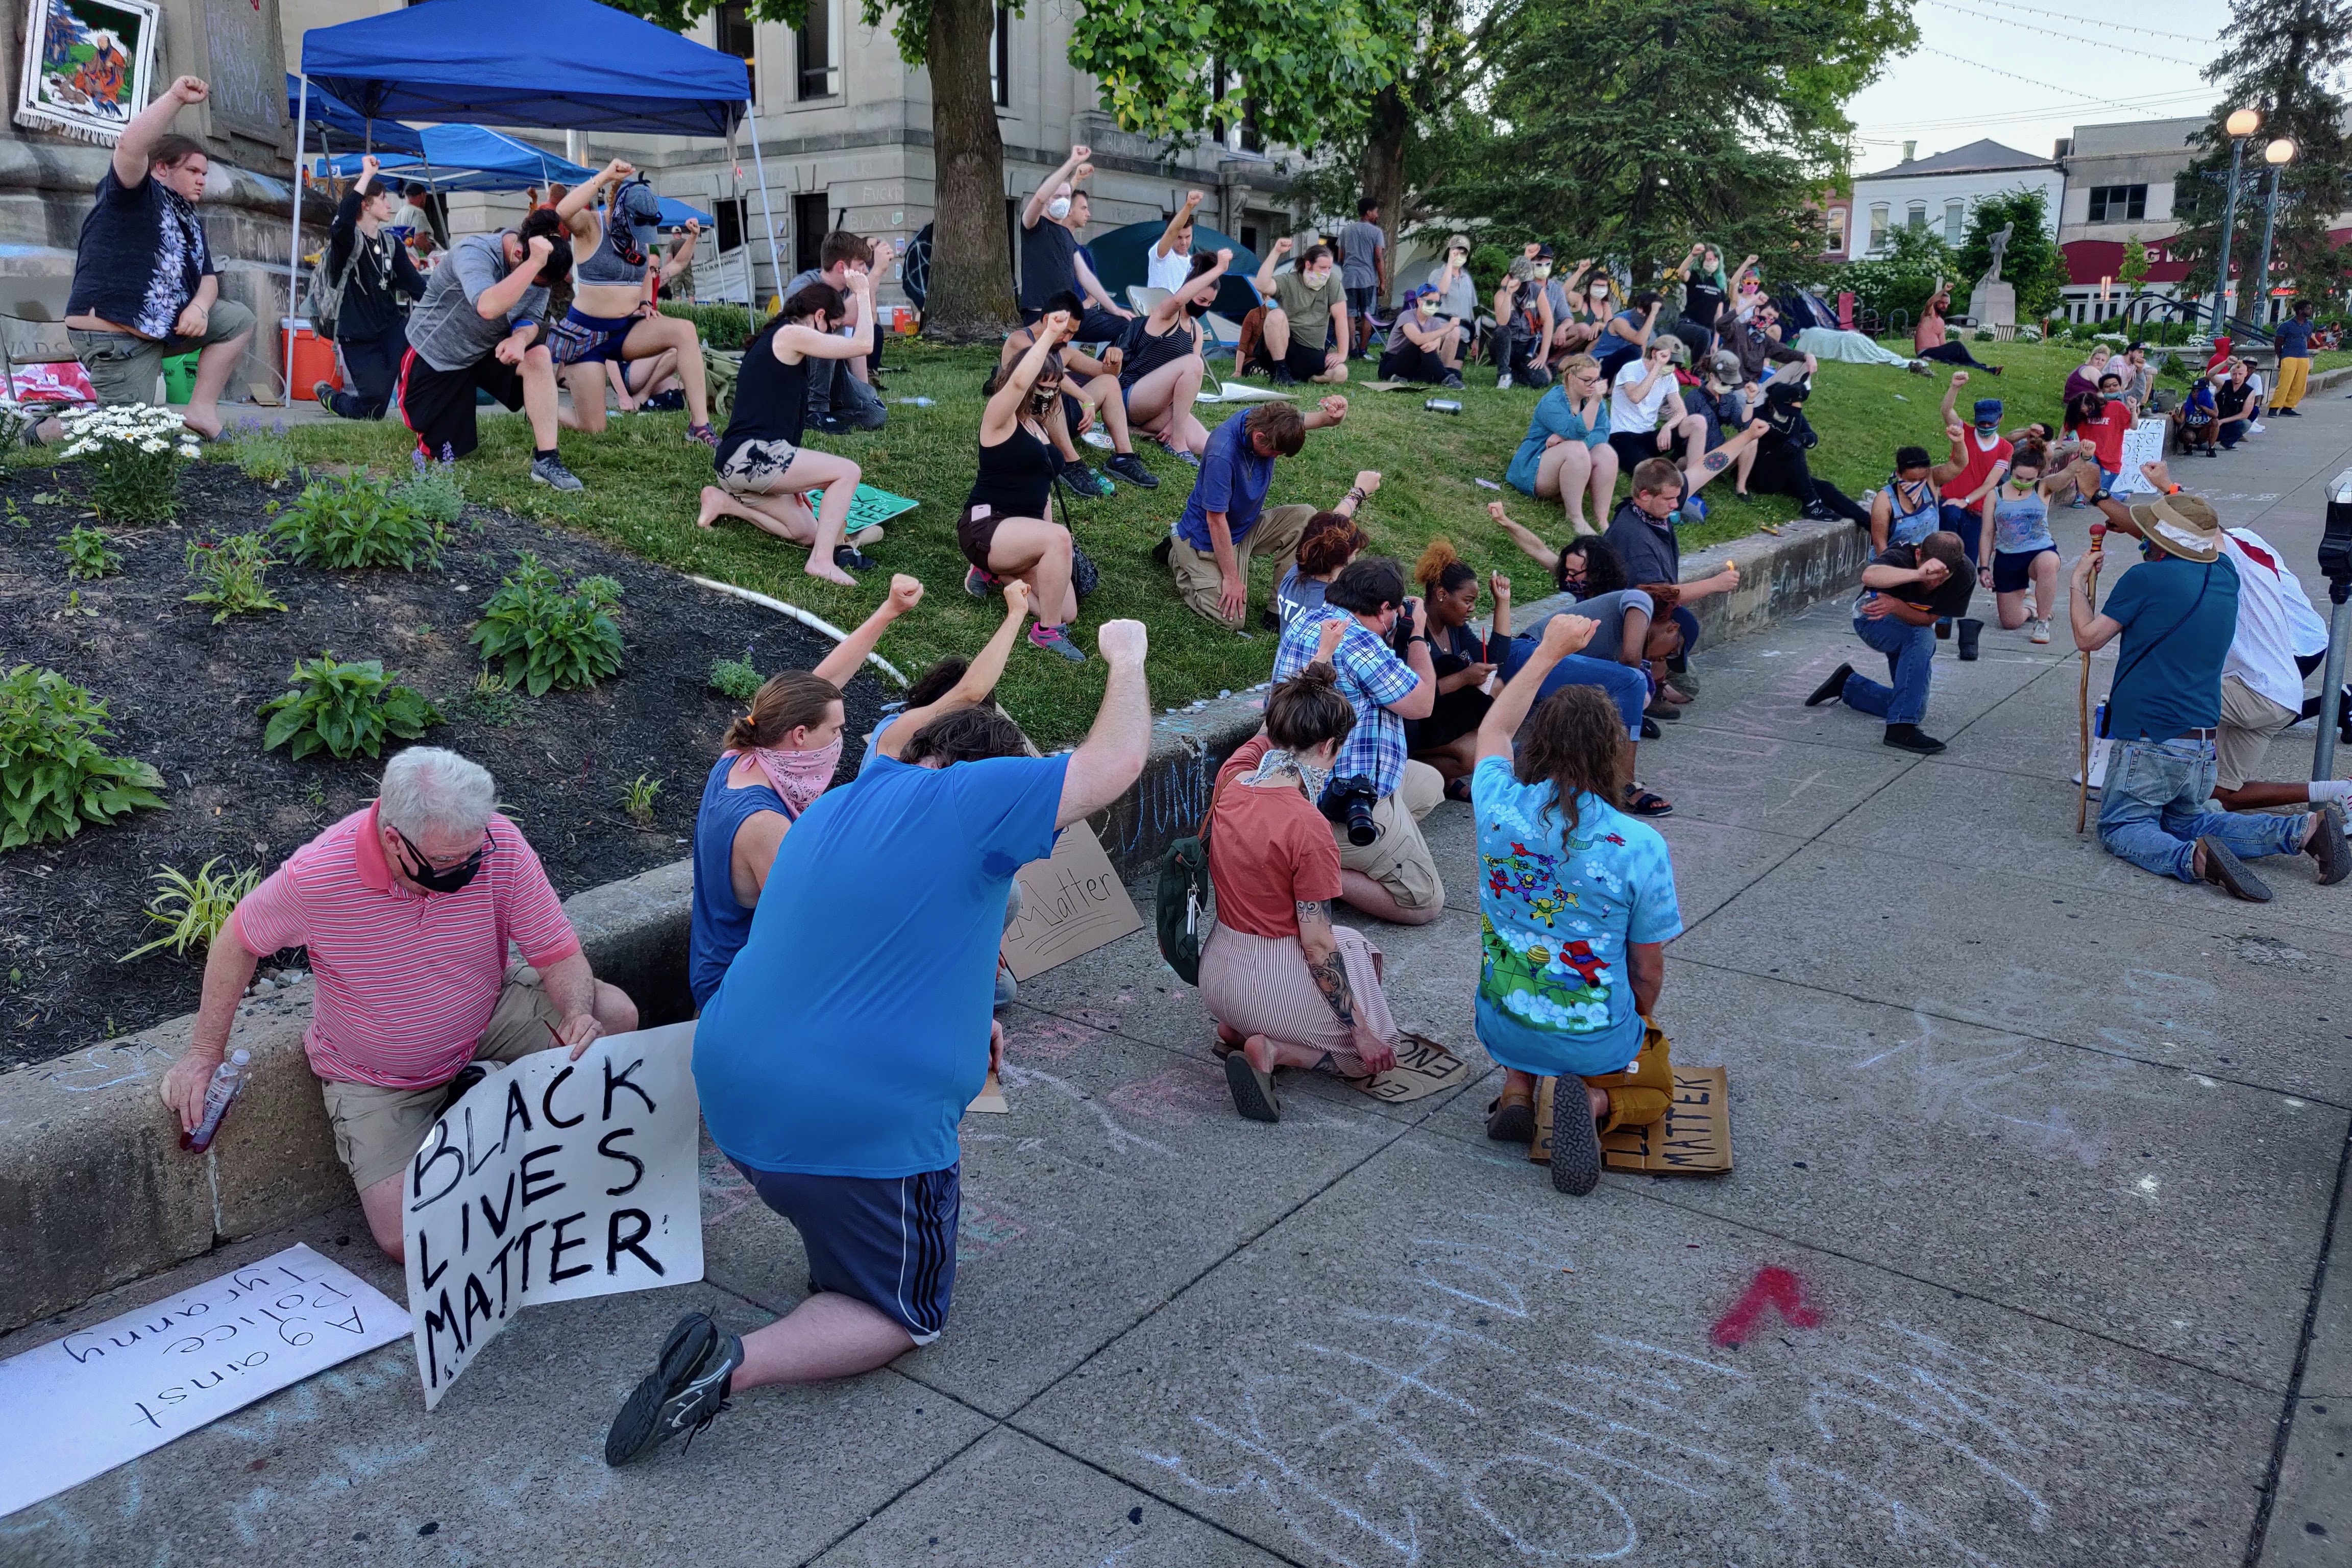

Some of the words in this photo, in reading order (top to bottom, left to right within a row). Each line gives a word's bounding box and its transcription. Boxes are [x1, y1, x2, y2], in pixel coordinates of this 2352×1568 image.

[1007, 868, 1111, 942] Matter
[411, 1055, 657, 1212] BLACK
[1661, 1074, 1723, 1169] MATTER
[419, 1127, 645, 1292] LIVES
[63, 1267, 325, 1363] Tyranny
[163, 1283, 354, 1354] Police
[425, 1208, 668, 1388] MATTER
